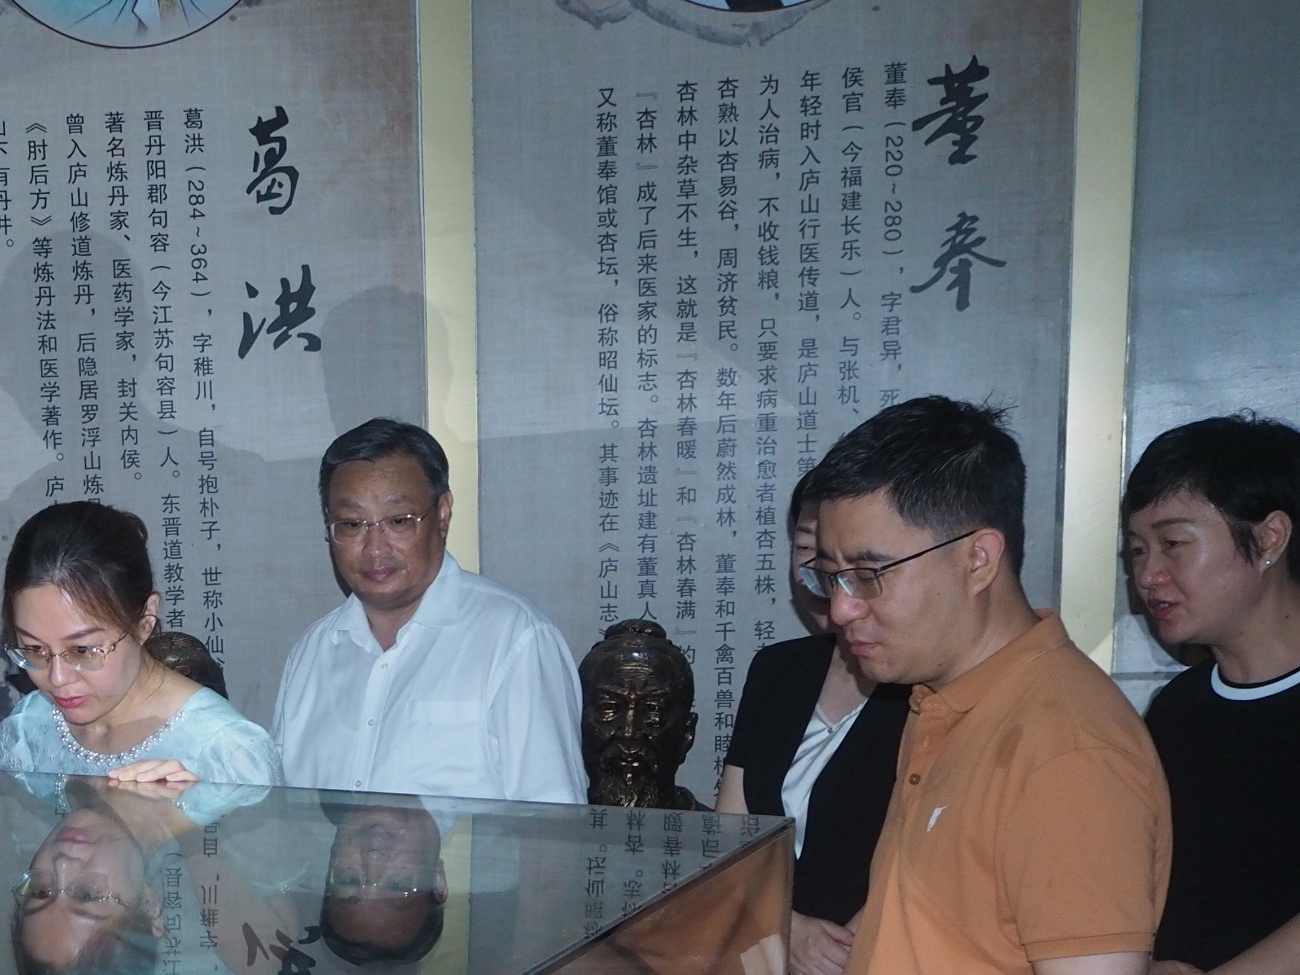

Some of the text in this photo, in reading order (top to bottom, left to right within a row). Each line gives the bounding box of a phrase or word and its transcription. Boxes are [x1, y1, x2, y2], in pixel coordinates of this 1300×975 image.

[25, 121, 64, 505] 《肘后方》等炼丹法和医学著作。庐
[65, 113, 104, 502] 曾入庐山修道炼丹，后隐居罗浮山炼
[238, 105, 322, 360] 葛洪
[837, 67, 864, 439] 侯官（今福建长乐）人。与张机、
[911, 55, 1006, 312] 董奉
[183, 107, 225, 666] 葛洪（284~364），字稚川，自号抱朴子，世称小仙
